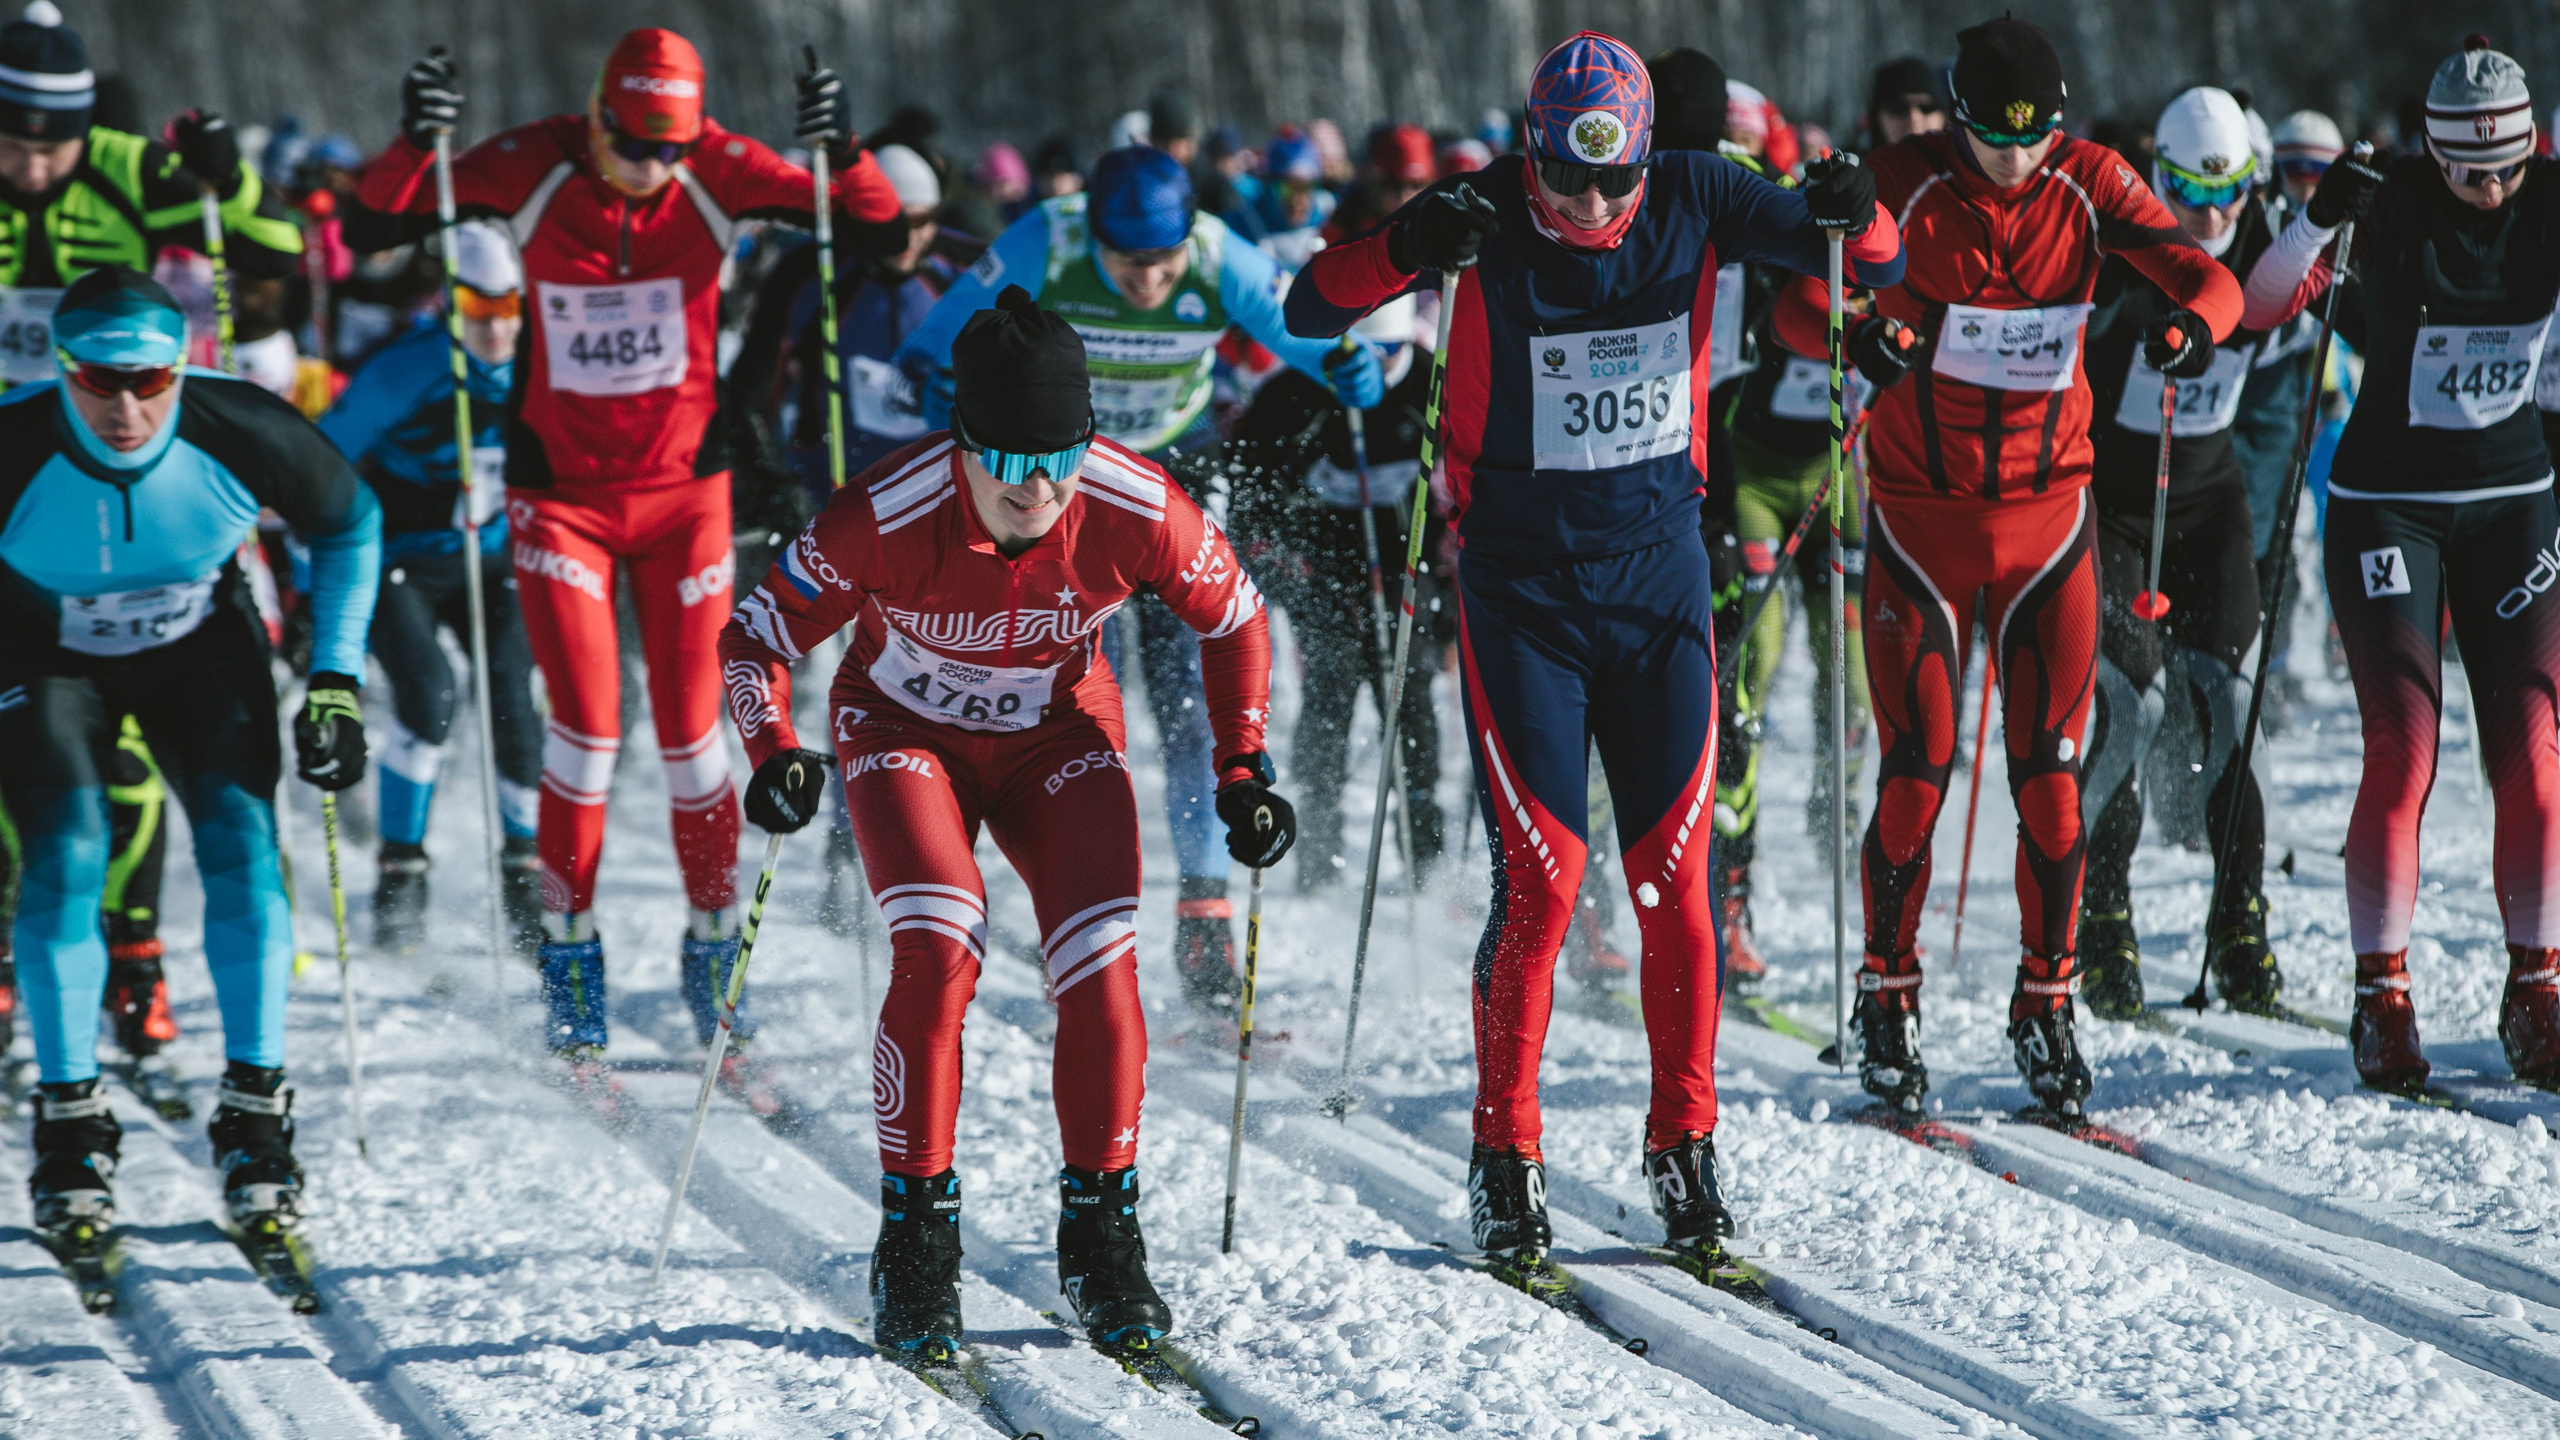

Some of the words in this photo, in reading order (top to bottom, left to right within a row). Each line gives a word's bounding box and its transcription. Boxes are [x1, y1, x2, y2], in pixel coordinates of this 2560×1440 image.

[568, 323, 663, 367] 4484
[1587, 333, 1637, 349] ЛЫЖНЯ
[1589, 345, 1638, 361] РОССИИ
[1590, 360, 1640, 378] 2024
[2437, 360, 2531, 402] 4482
[1563, 375, 1670, 437] 3056
[513, 541, 607, 602] LUKOIL
[938, 661, 993, 679] ЛЫЖНЯ
[846, 752, 934, 782] LUKOIL
[1044, 751, 1130, 795] BOSCO
